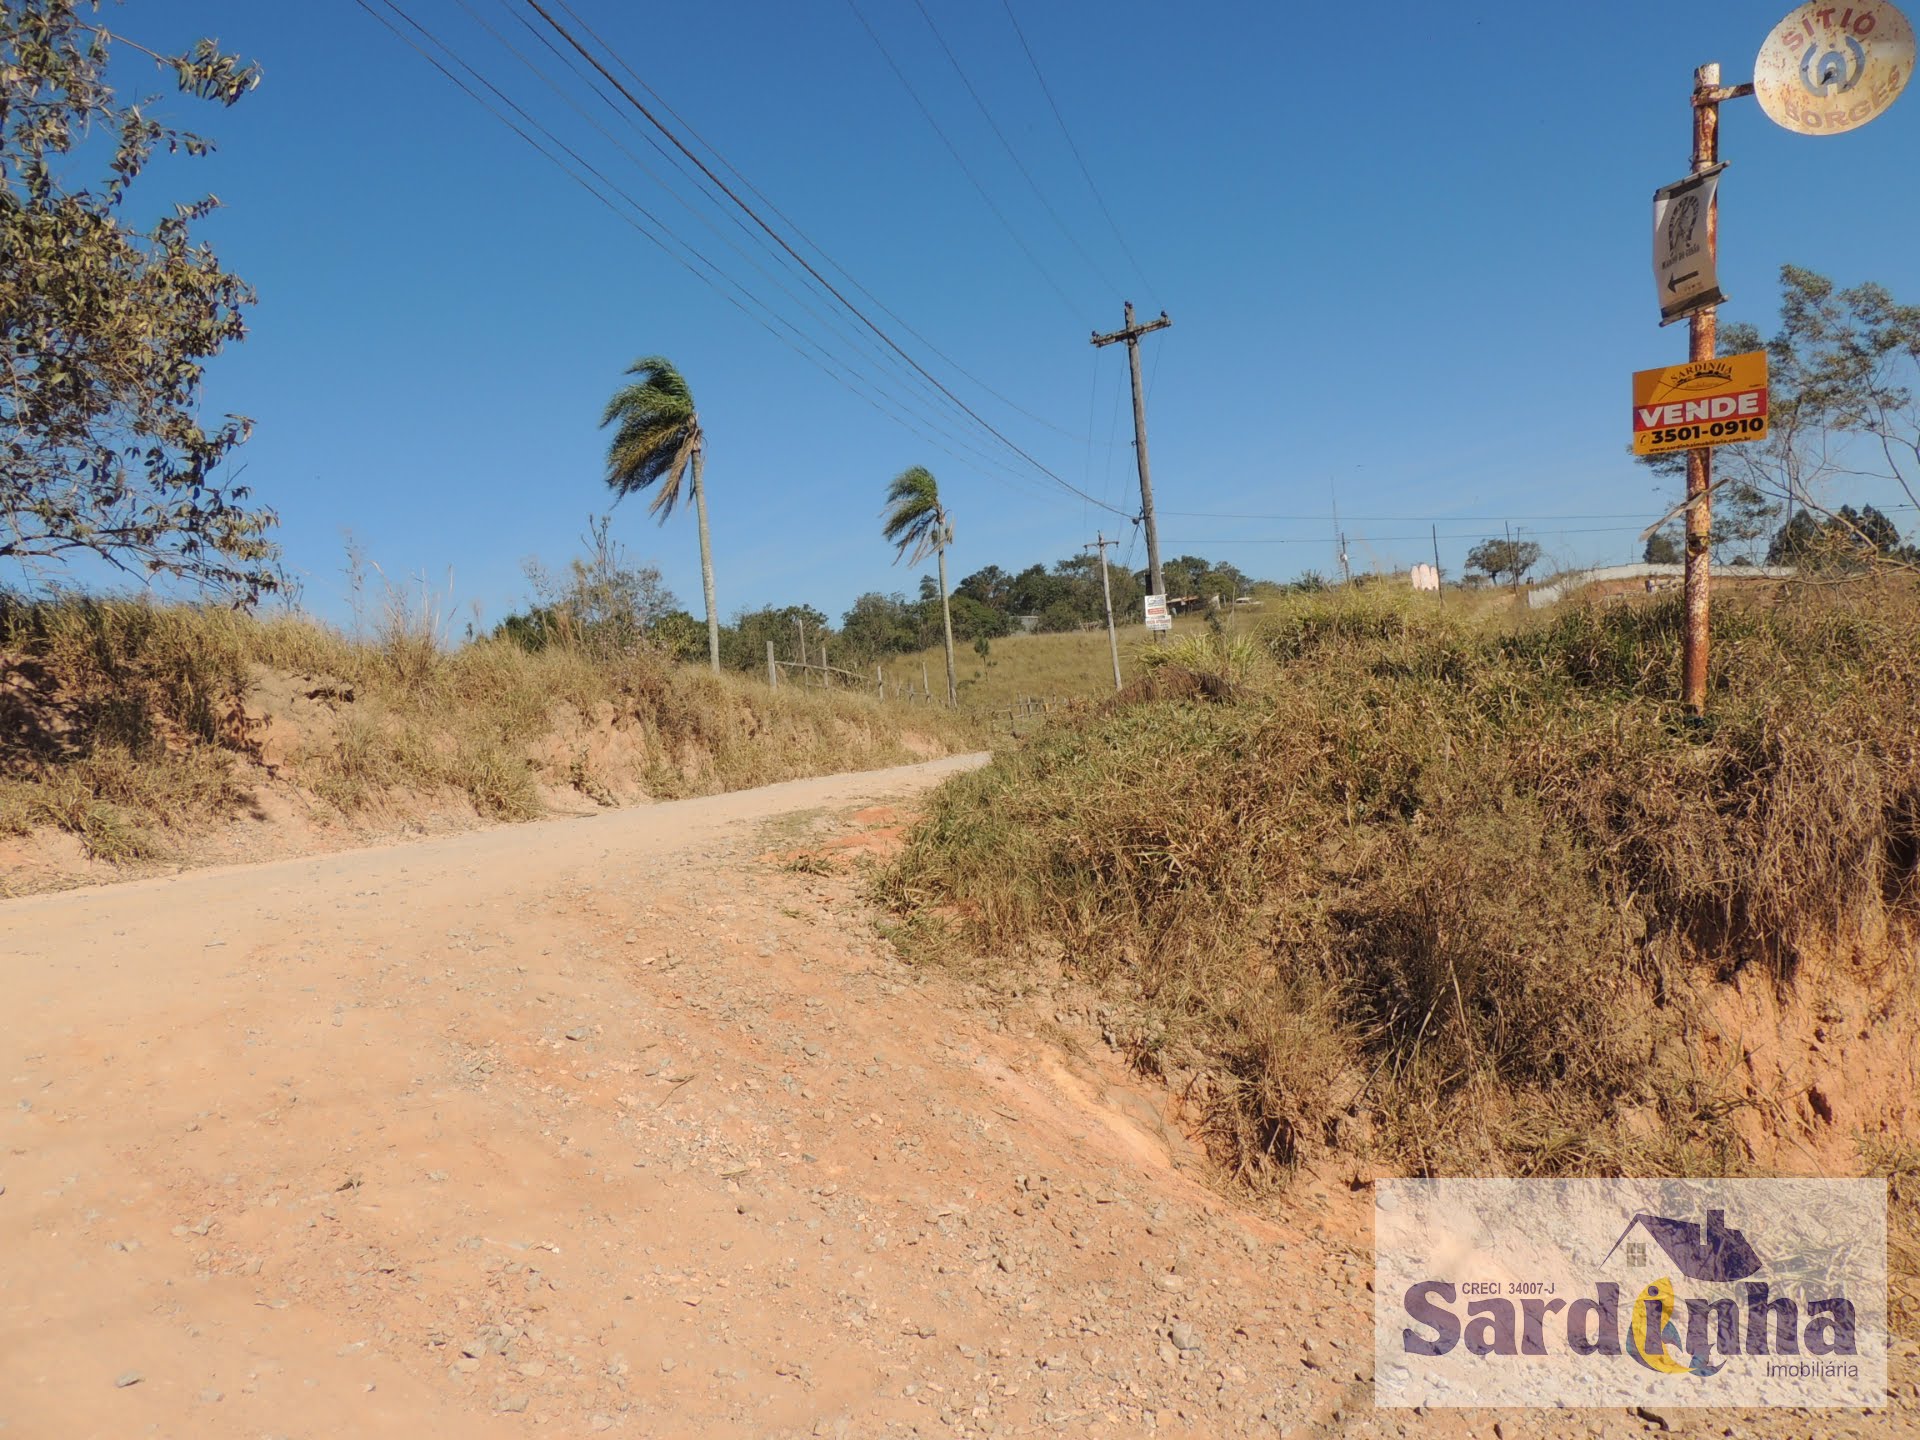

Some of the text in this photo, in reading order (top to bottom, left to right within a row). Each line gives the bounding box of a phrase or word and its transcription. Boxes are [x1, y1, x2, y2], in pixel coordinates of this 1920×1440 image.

[1670, 362, 1733, 381] SARDINHA
[1638, 392, 1759, 428] VENDE
[1651, 417, 1764, 444] 3501-0910
